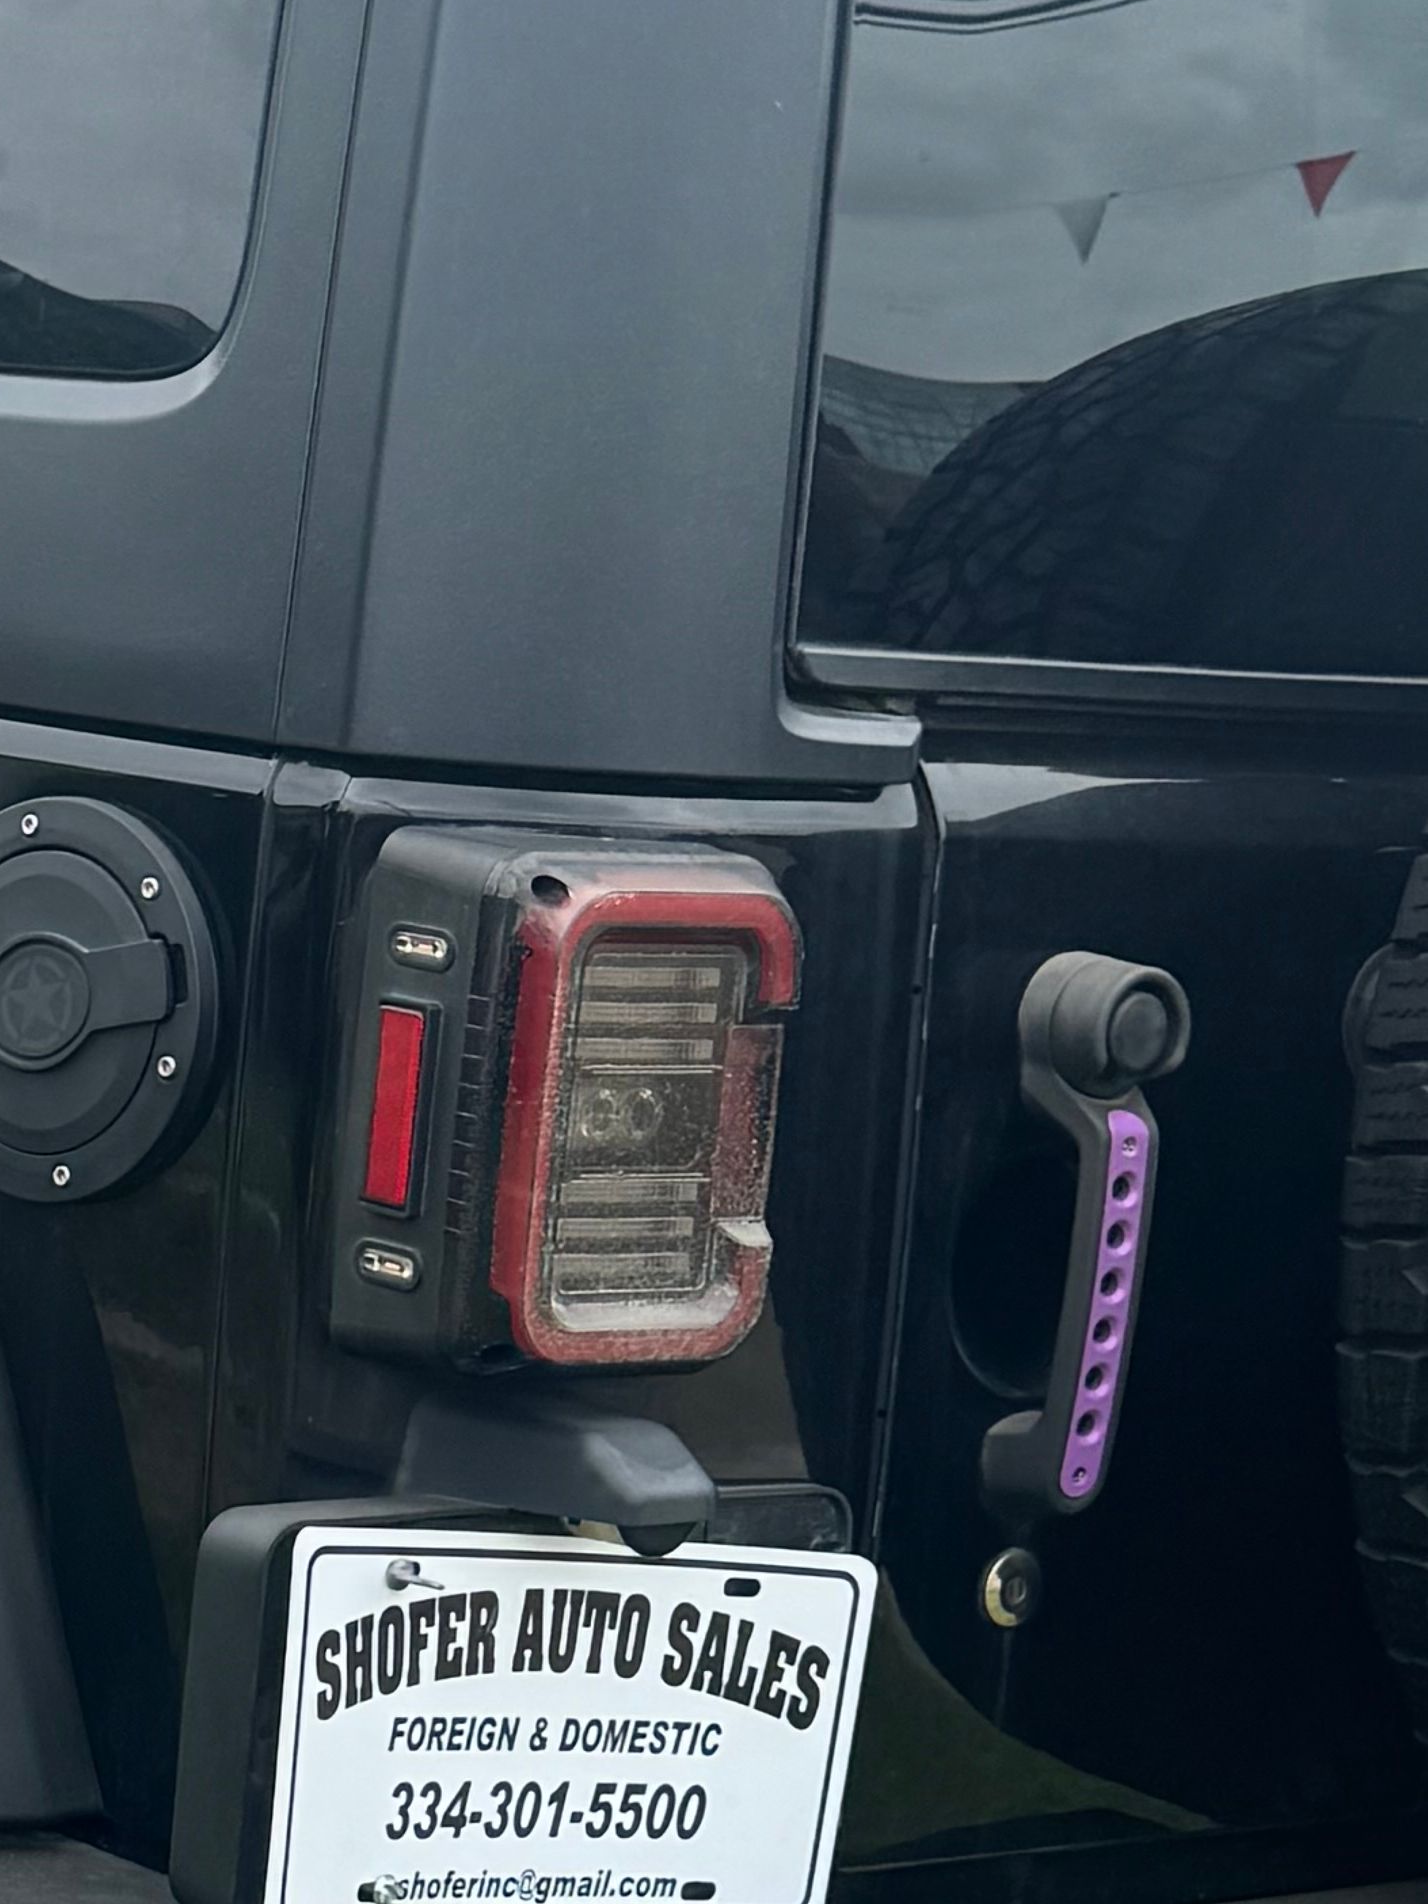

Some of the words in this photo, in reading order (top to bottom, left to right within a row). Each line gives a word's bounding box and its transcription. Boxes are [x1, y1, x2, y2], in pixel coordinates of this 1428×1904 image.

[316, 1590, 499, 1721] SHOFER
[511, 1588, 651, 1679] AUTO
[660, 1602, 831, 1731] SALES
[388, 1716, 521, 1752] FOREIGN
[529, 1717, 548, 1752] &
[558, 1718, 722, 1756] DOMESTIC
[385, 1780, 707, 1840] 334-301-5500
[394, 1870, 677, 1904] shoferinc@gmail.com
